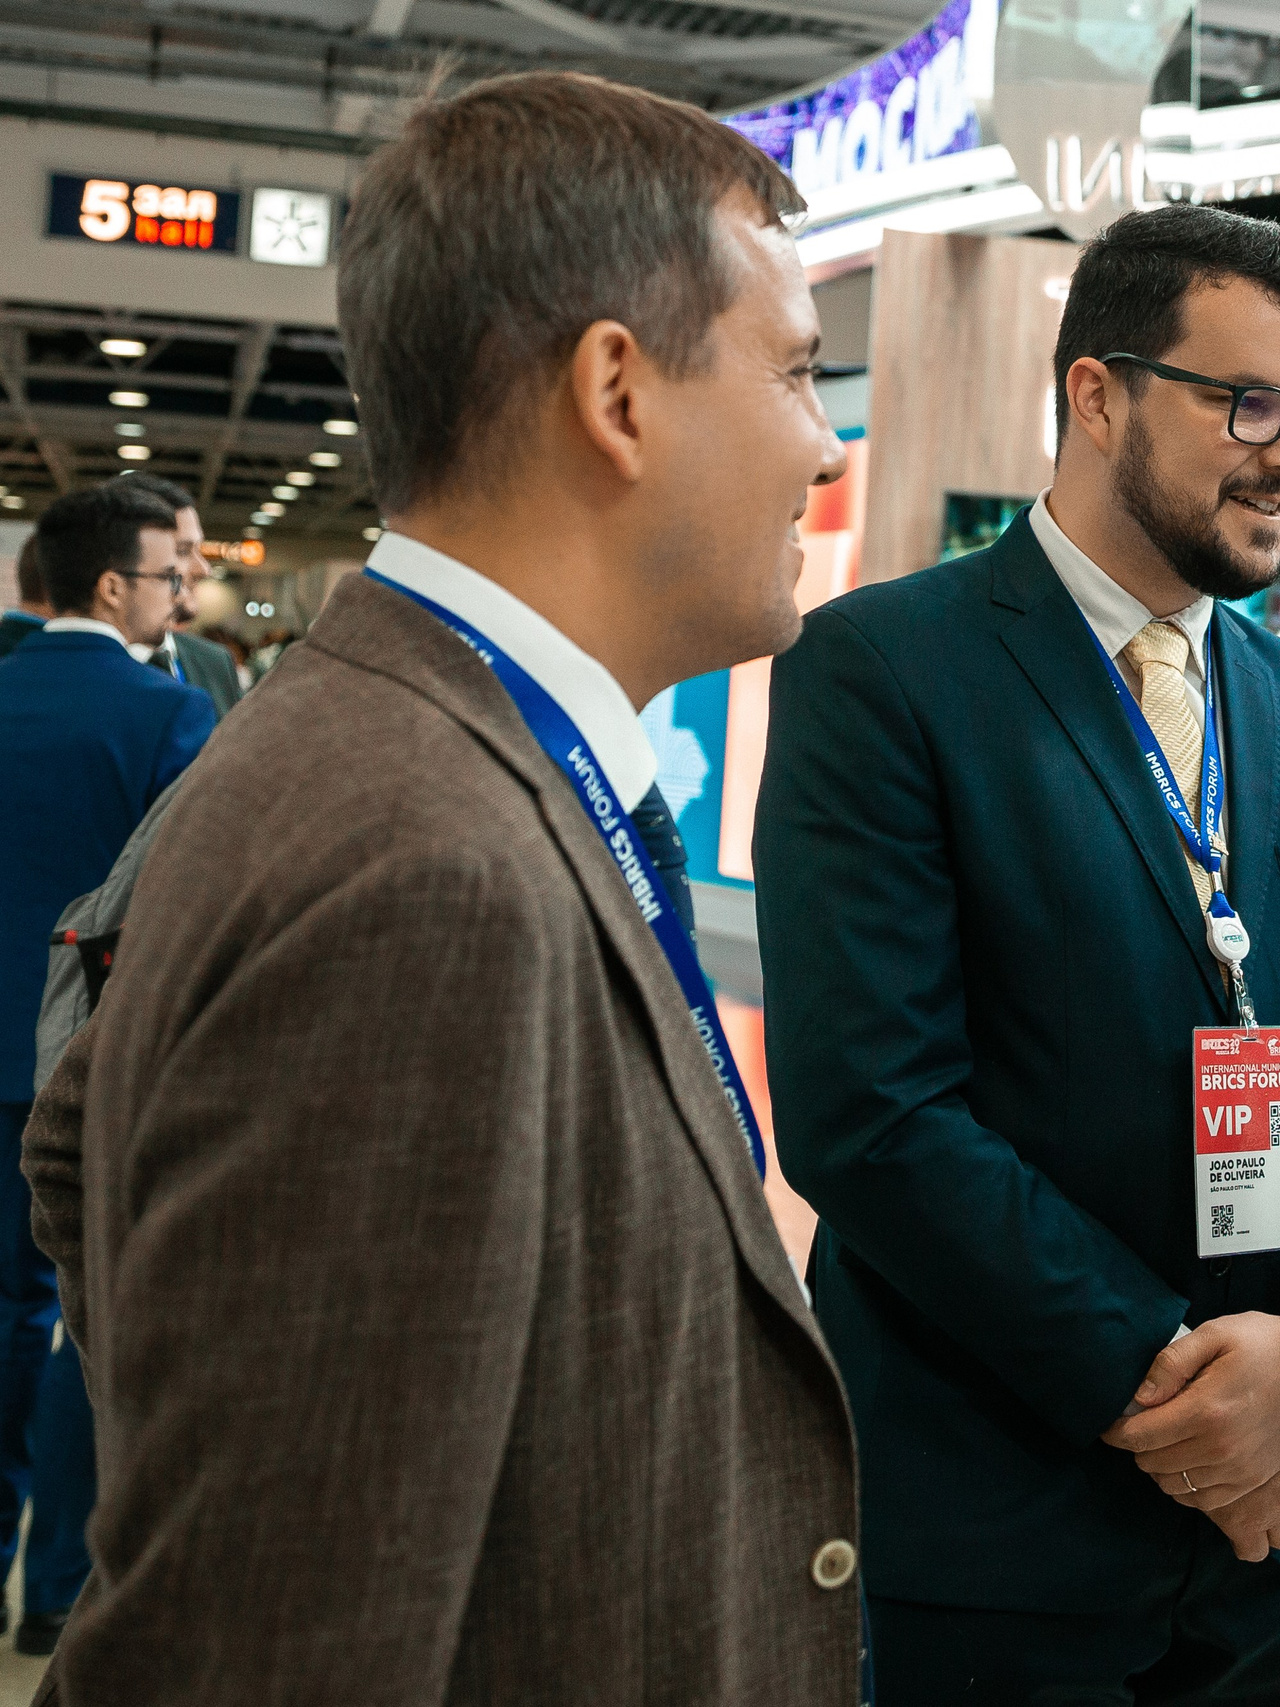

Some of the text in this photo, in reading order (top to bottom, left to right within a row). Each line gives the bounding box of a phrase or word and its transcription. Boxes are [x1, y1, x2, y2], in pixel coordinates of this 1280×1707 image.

[79, 179, 131, 242] 5
[1207, 755, 1218, 806] FORUM
[1145, 751, 1203, 847] IMBRICS FOR
[566, 744, 663, 924] IMBRICS FORUM
[1201, 1064, 1260, 1074] INTERNATIONAL
[1201, 1073, 1246, 1091] BRICS
[1202, 1104, 1252, 1137] VIP
[1209, 1157, 1266, 1171] JOAO PAULO
[1210, 1169, 1265, 1183] DE OLIVEIRA
